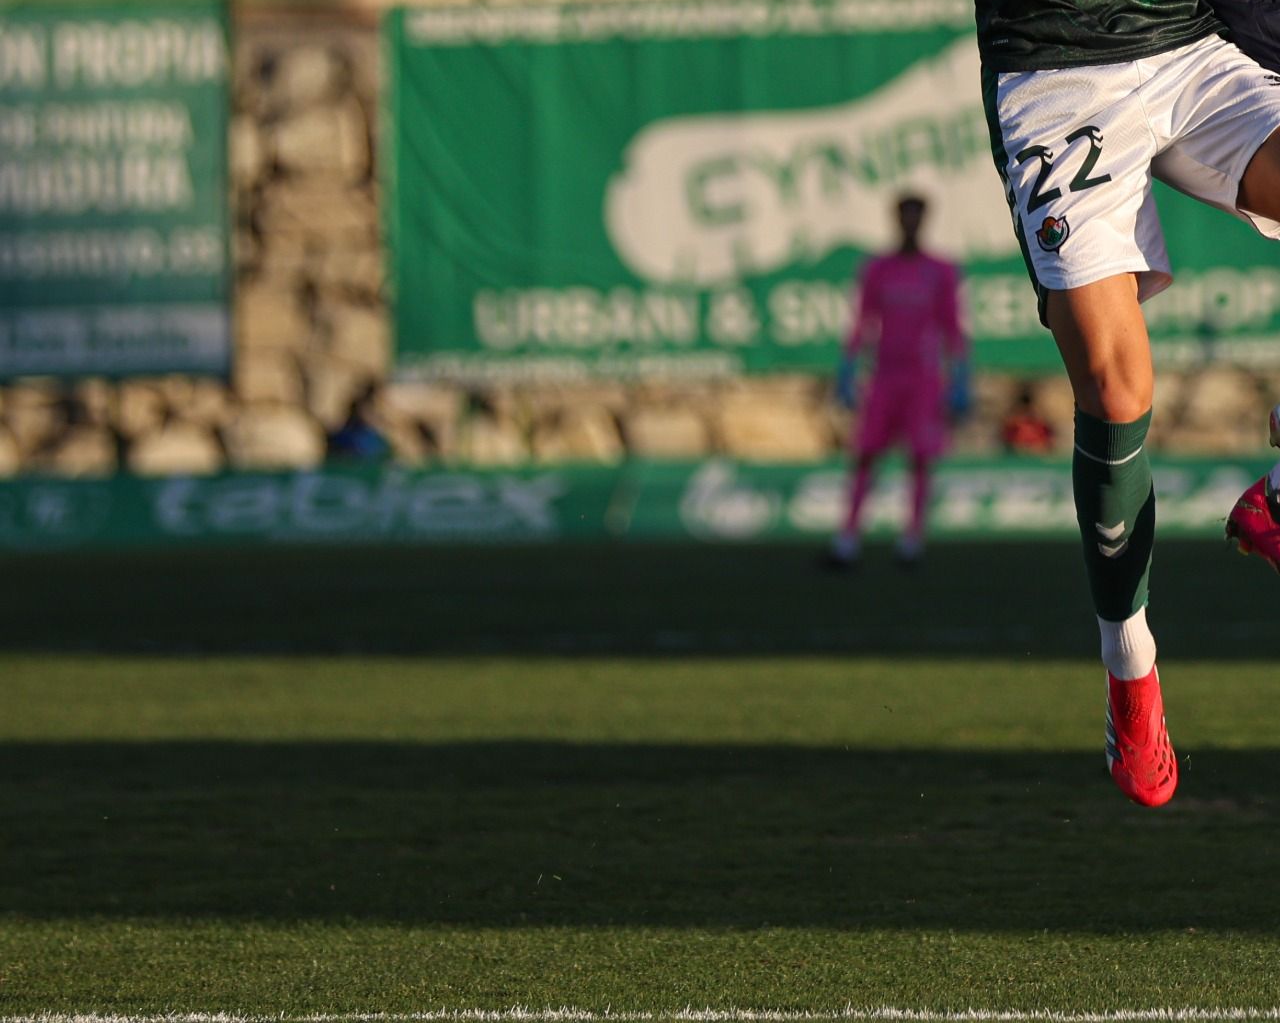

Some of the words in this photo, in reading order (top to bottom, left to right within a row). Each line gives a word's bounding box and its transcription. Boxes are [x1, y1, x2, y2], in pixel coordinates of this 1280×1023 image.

[1016, 125, 1112, 215] 22
[475, 285, 697, 348] URBAN
[709, 283, 760, 345] &
